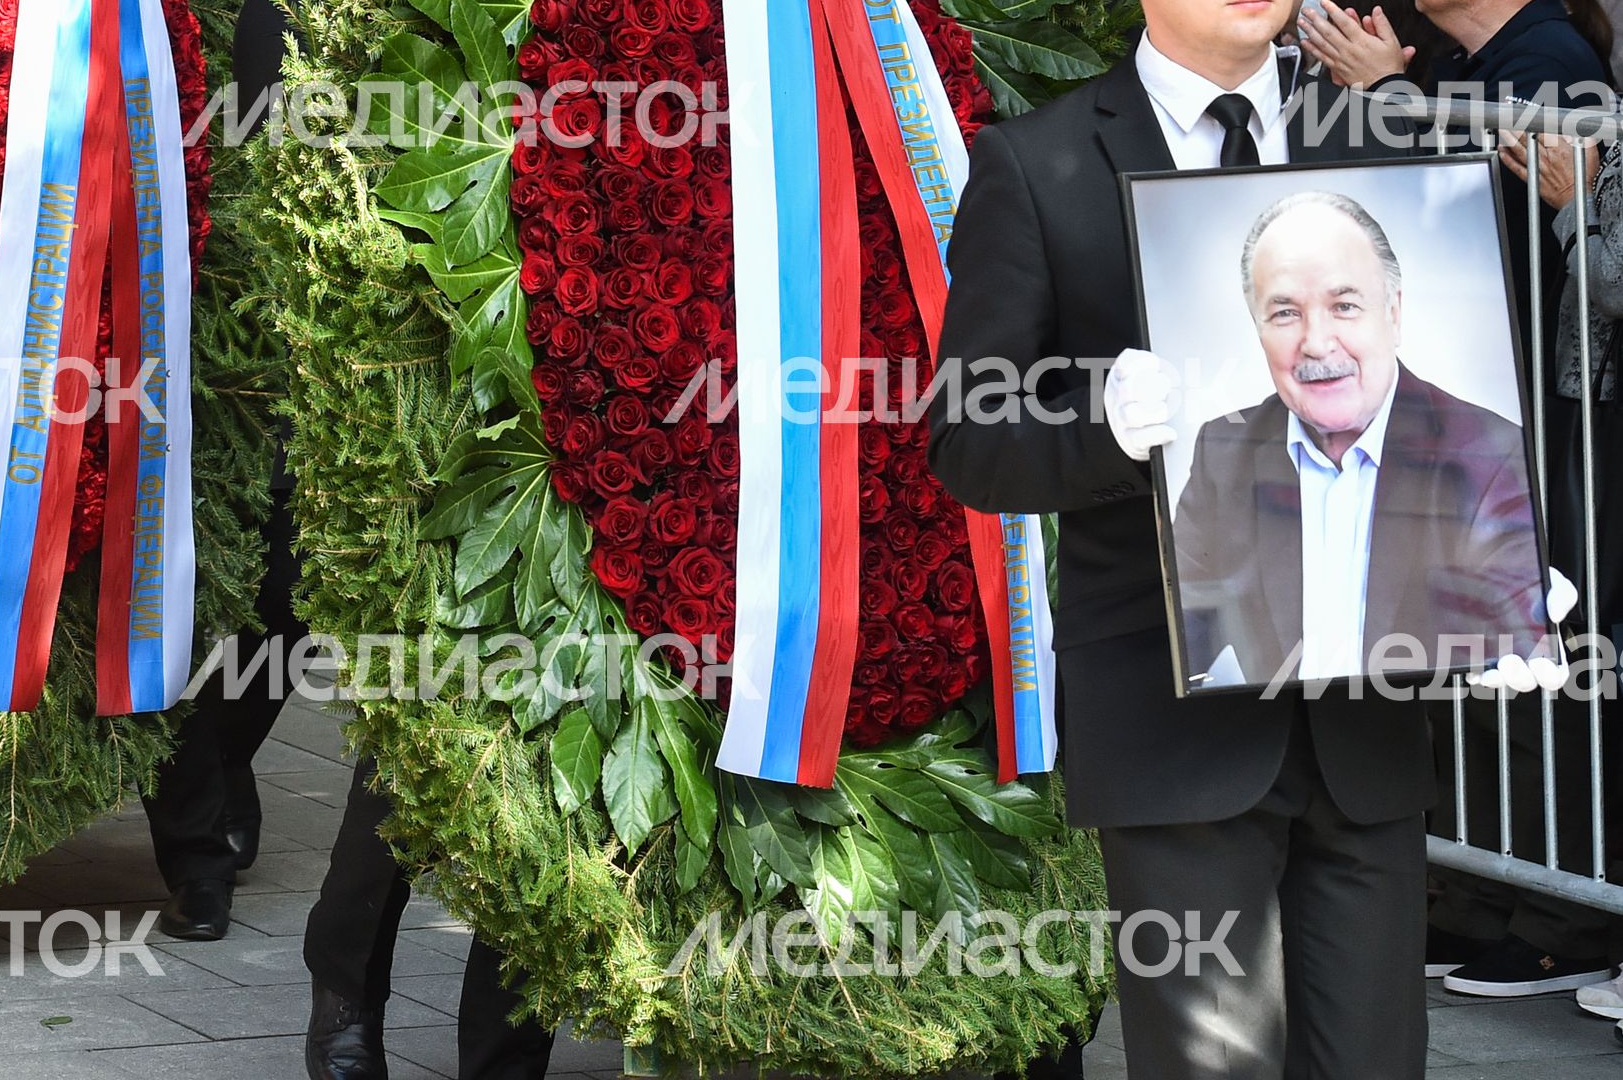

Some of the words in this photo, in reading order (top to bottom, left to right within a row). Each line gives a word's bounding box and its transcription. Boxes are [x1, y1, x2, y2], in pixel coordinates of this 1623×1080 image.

[124, 77, 163, 257] ПРЕЗИДЕНТА
[878, 41, 958, 245] ПРЕЗИДЕНТА
[13, 181, 79, 435] АДМИНИСТРАЦИИ
[139, 271, 171, 462] РОССИЙСКОЙ
[6, 440, 44, 486] ОТ
[126, 474, 165, 642] ФЕДЕРАЦИИ
